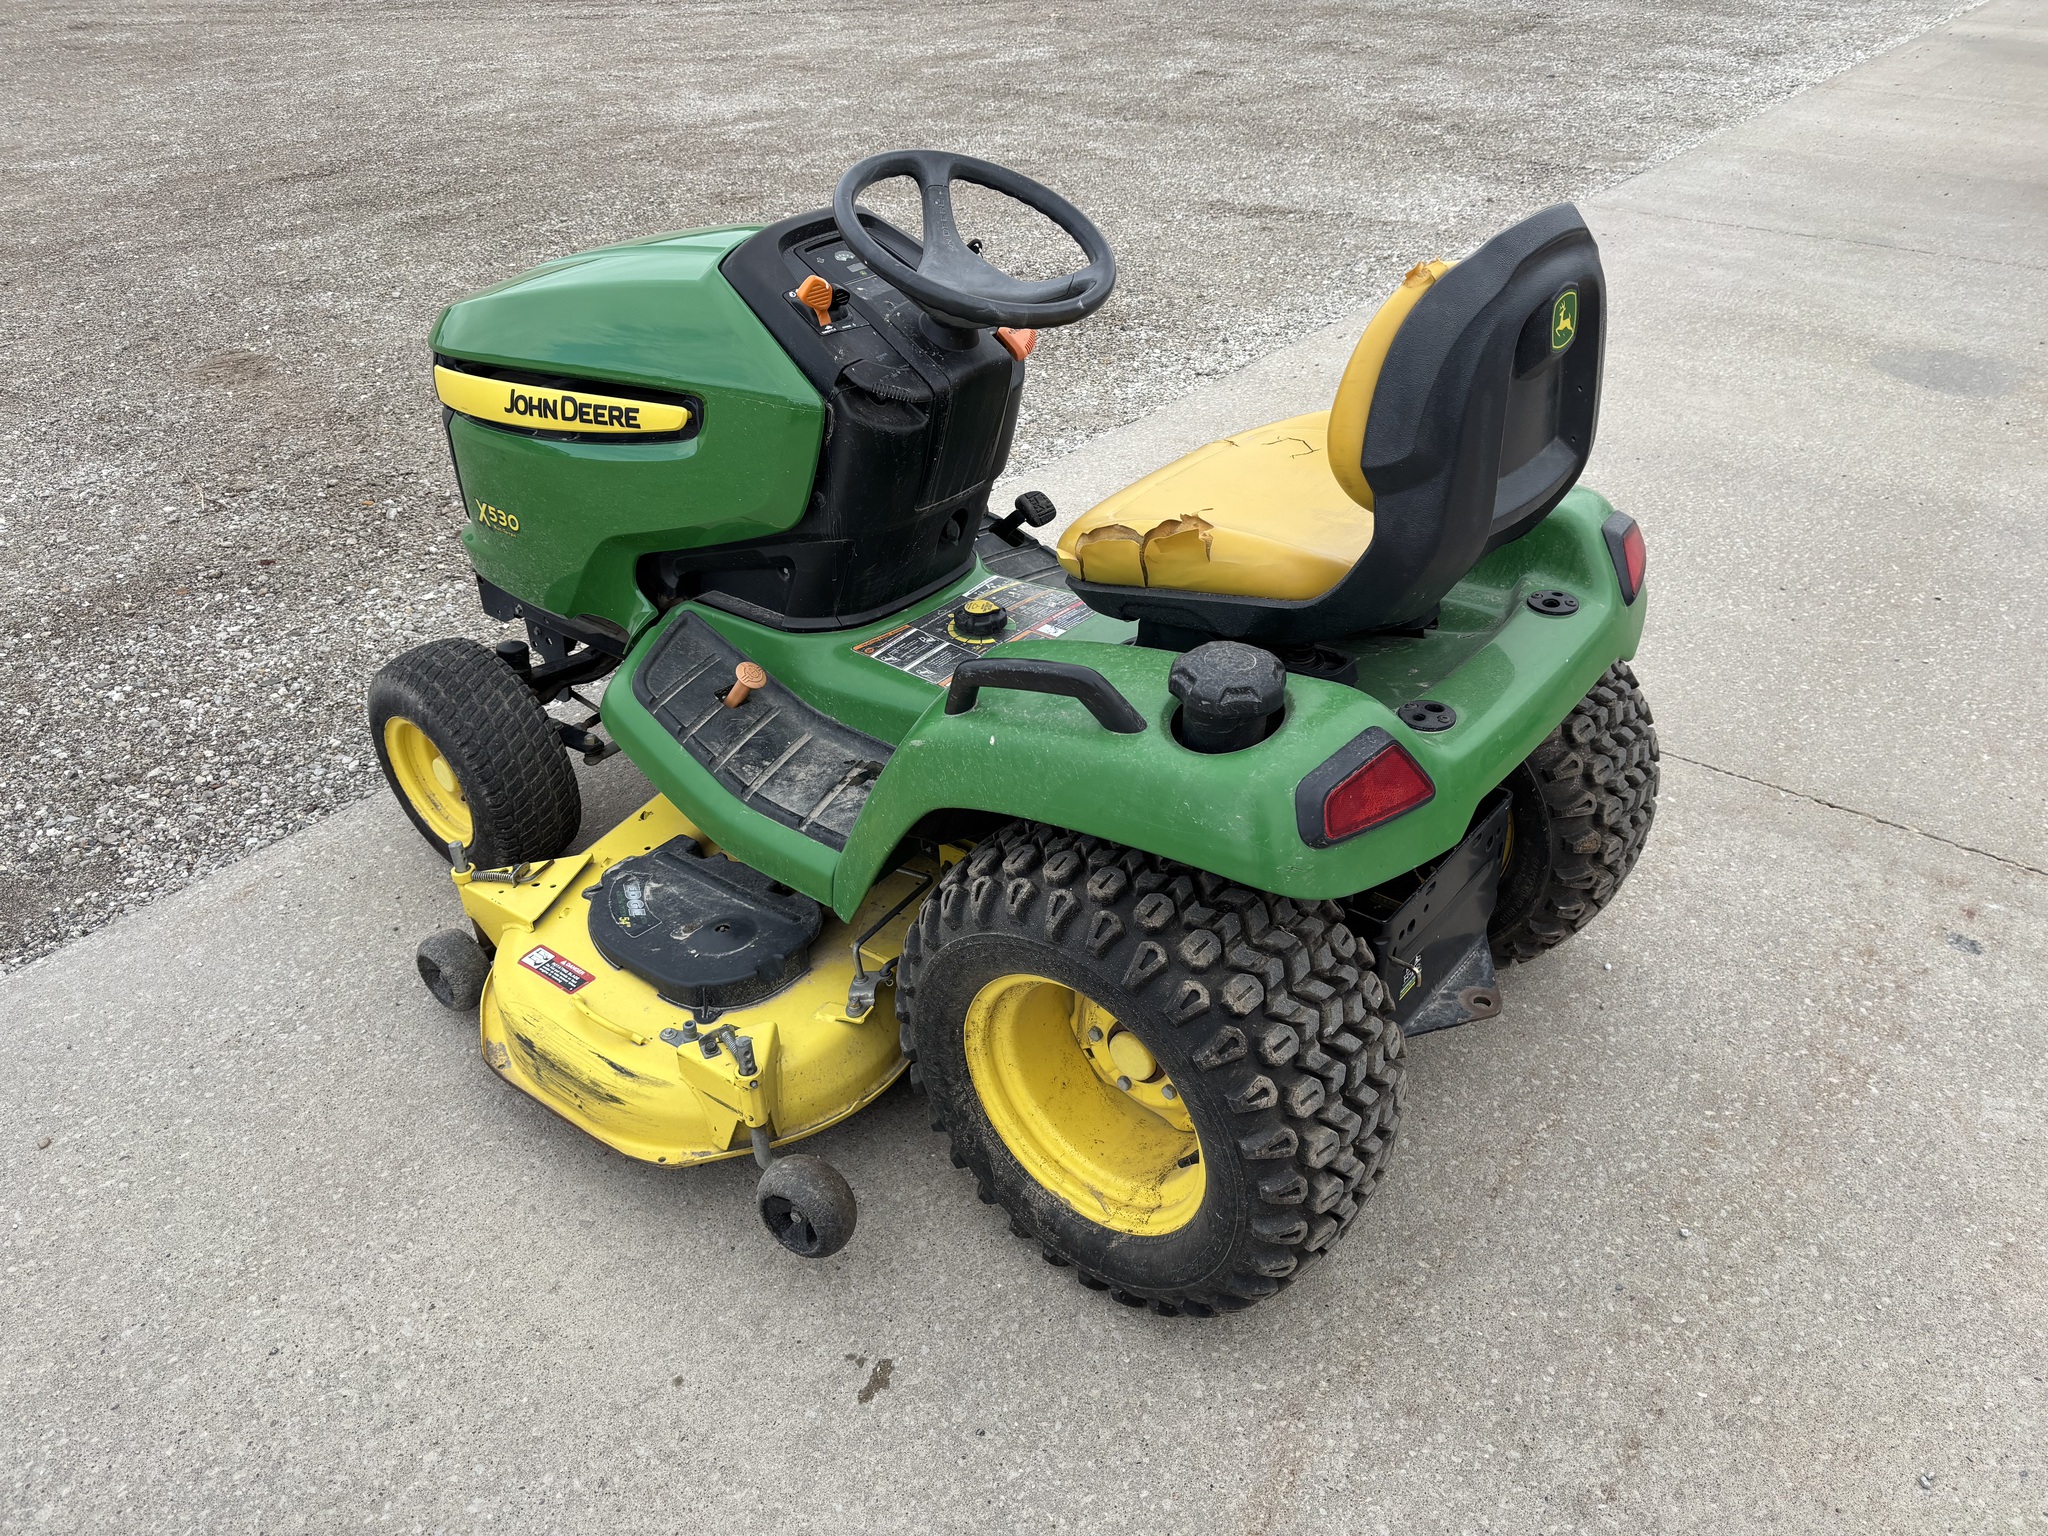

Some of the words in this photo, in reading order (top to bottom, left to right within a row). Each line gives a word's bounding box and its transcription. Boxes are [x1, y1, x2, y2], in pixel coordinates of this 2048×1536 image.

[504, 389, 558, 420] JOHN
[561, 396, 642, 429] DEERE
[475, 498, 519, 531] X530
[622, 883, 647, 916] EDGE
[565, 962, 585, 975] DANGER
